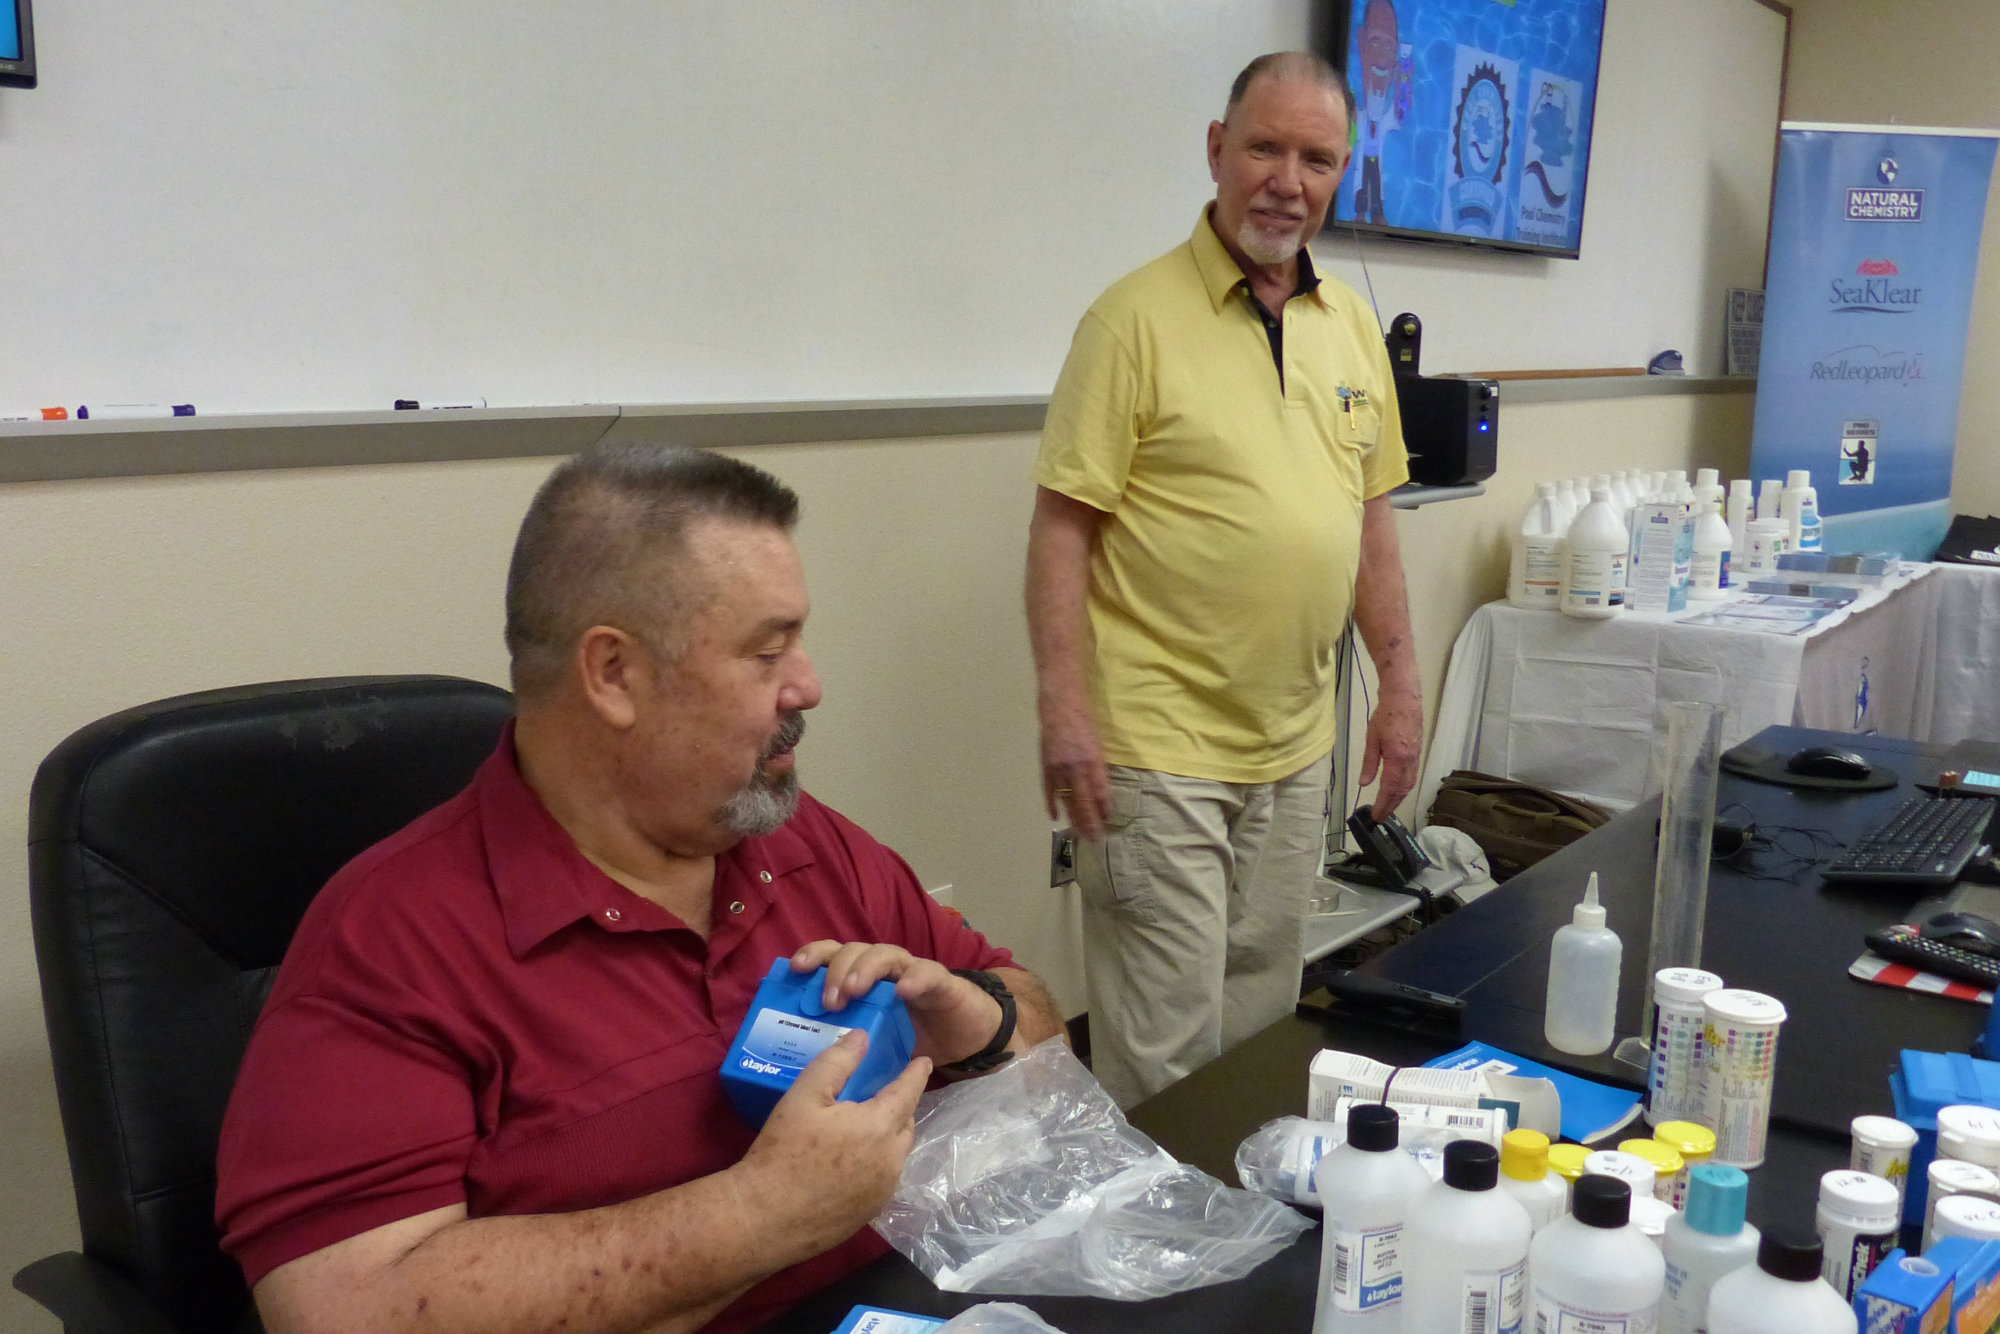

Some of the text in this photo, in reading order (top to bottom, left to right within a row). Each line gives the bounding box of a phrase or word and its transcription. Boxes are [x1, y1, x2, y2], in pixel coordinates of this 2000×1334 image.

[1851, 192, 1918, 206] NATURAL
[1850, 206, 1918, 218] CHEMISTRY
[1830, 278, 1922, 304] SeaKlear
[1810, 360, 1908, 385] RedLeopard
[748, 1058, 781, 1075] taylor
